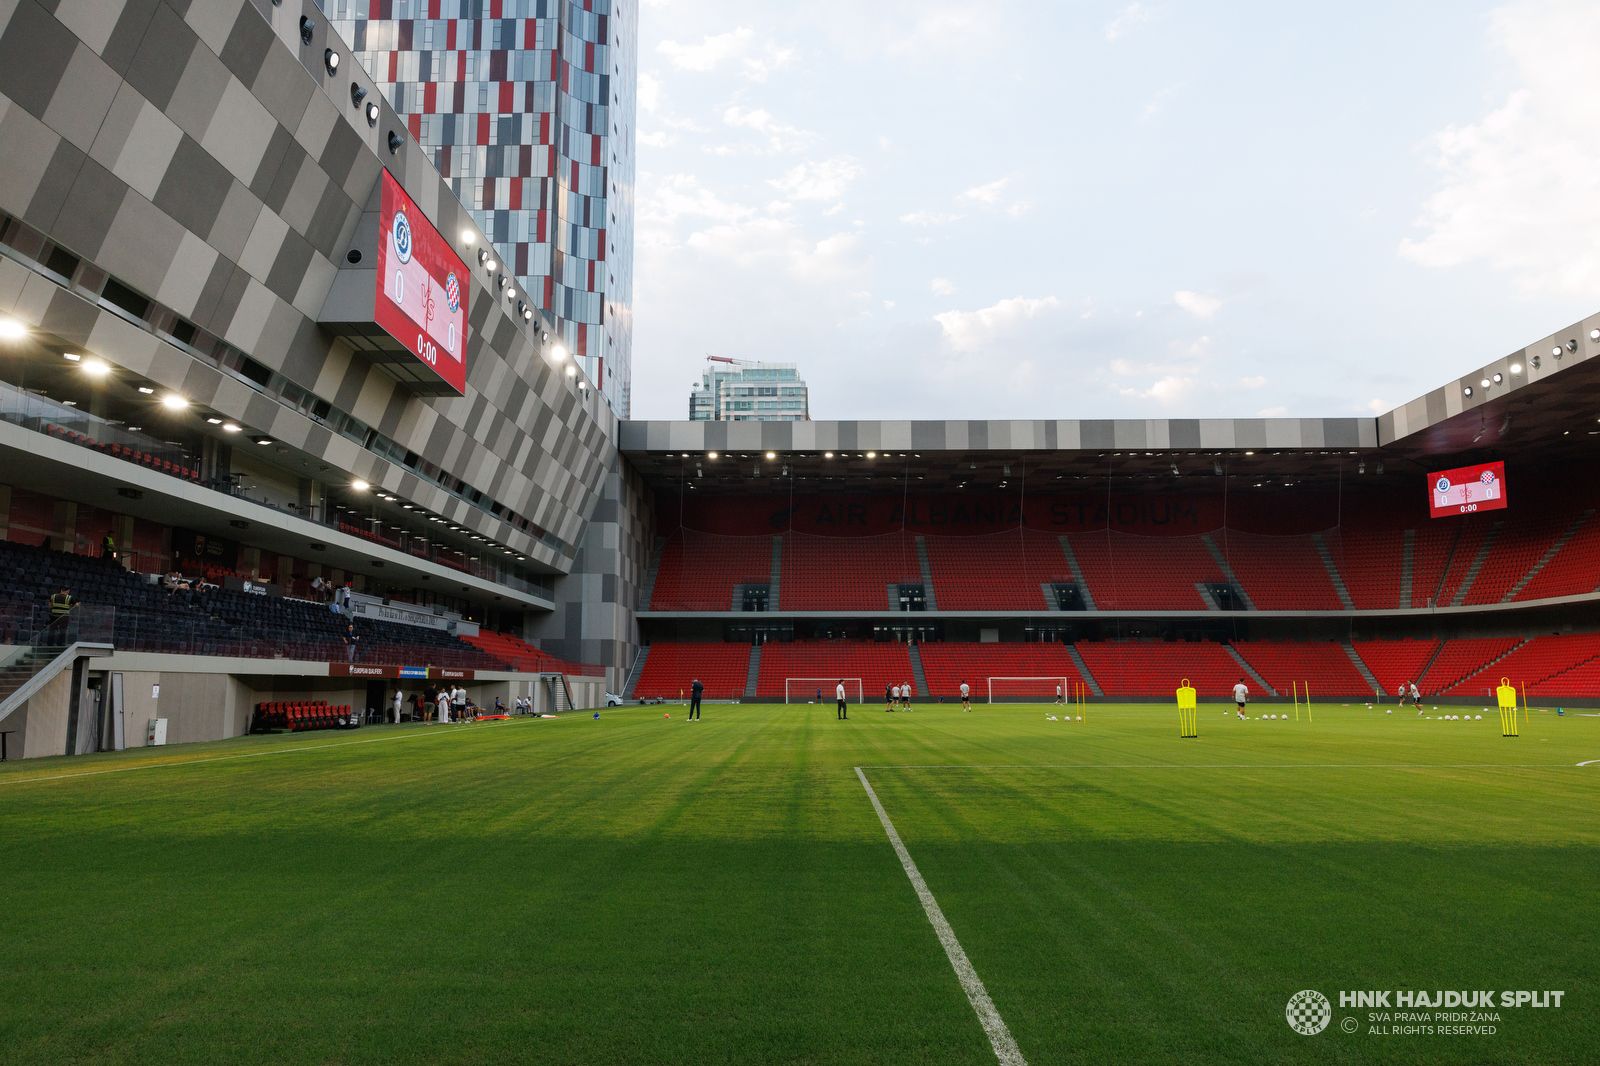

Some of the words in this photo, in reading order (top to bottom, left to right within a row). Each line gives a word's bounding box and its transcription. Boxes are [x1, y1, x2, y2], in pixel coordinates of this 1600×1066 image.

[395, 269, 404, 304] 0
[448, 322, 455, 352] 0
[417, 334, 437, 365] 0:00
[1441, 495, 1447, 505] 0
[1486, 488, 1492, 498] 0
[815, 503, 868, 526] AIR
[887, 502, 1028, 525] ALBANIA
[1050, 502, 1198, 525] STADIUM
[1460, 504, 1477, 512] 0:00
